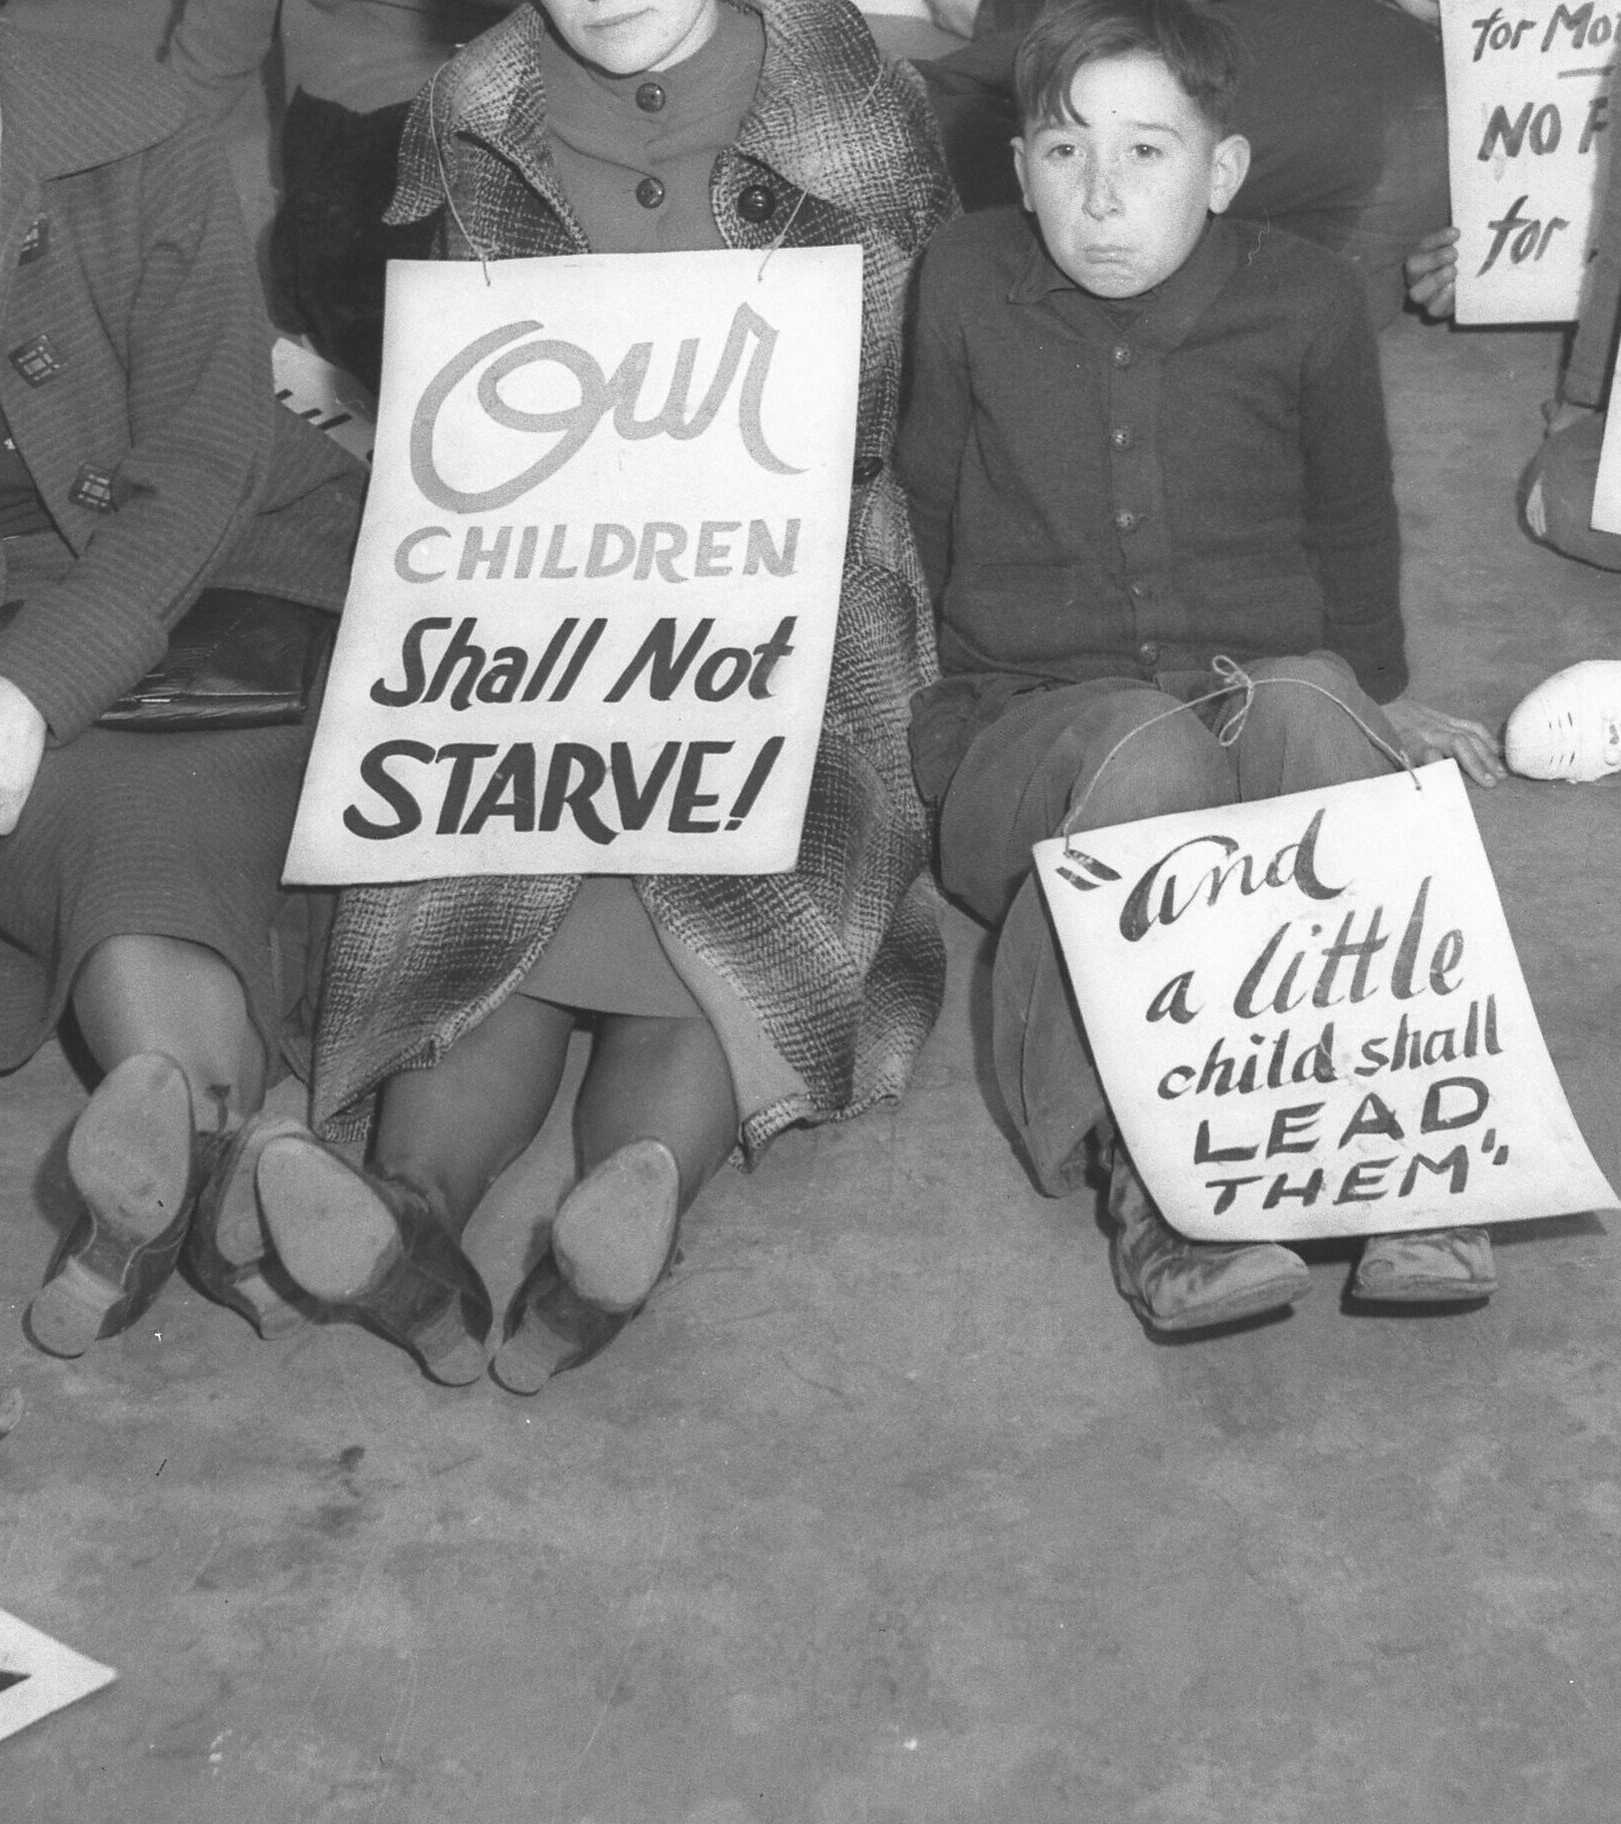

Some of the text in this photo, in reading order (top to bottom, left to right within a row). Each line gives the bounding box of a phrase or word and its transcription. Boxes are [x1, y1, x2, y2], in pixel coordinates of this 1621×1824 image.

[1472, 7, 1538, 62] for
[1478, 100, 1563, 162] NO
[1477, 194, 1570, 279] for
[409, 300, 812, 515] Our
[393, 517, 802, 584] CHILDREN
[369, 614, 800, 712] Shall Not
[342, 734, 787, 846] STARVE!
[1145, 874, 1465, 1025] a little
[1157, 994, 1506, 1101] child shall
[1193, 1076, 1491, 1166] LEAD
